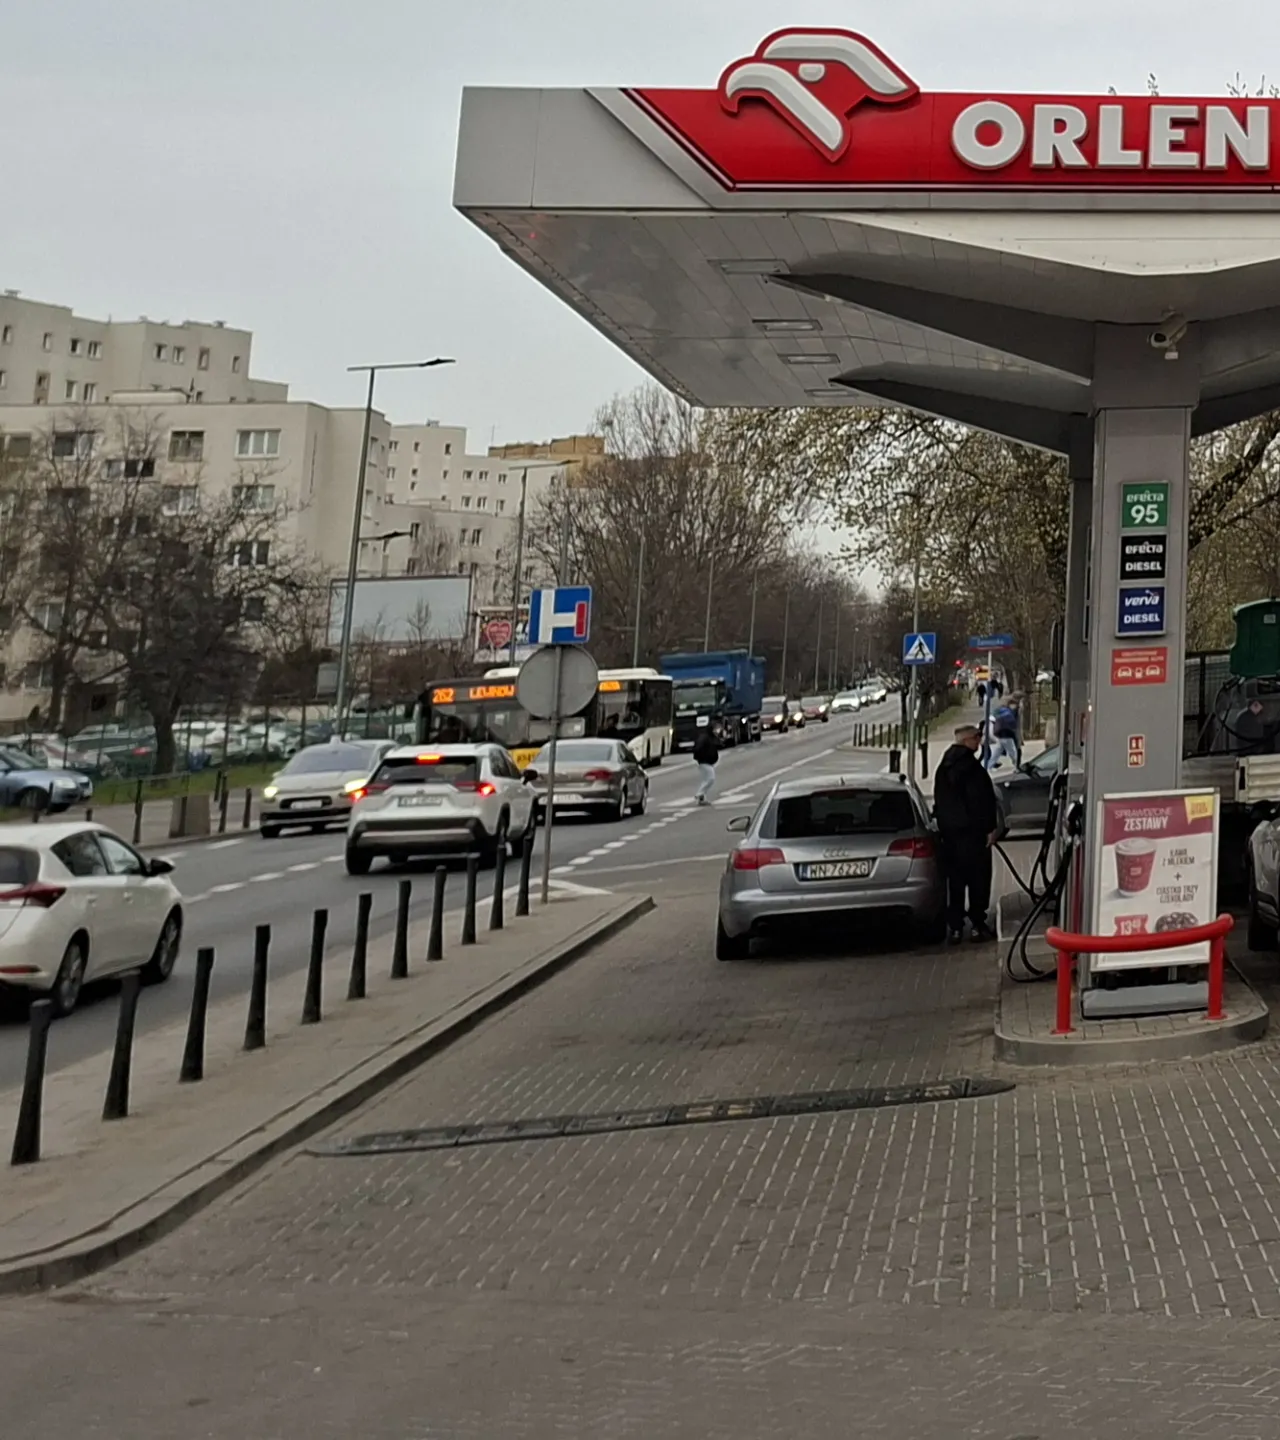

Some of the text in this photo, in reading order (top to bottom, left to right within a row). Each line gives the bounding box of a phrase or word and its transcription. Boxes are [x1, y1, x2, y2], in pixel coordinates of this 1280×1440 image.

[951, 100, 1270, 169] ORLEN
[1131, 504, 1159, 524] 95
[1125, 561, 1162, 572] DIESEL
[1123, 613, 1160, 625] DIESEL
[1123, 817, 1168, 831] ZESTAWY
